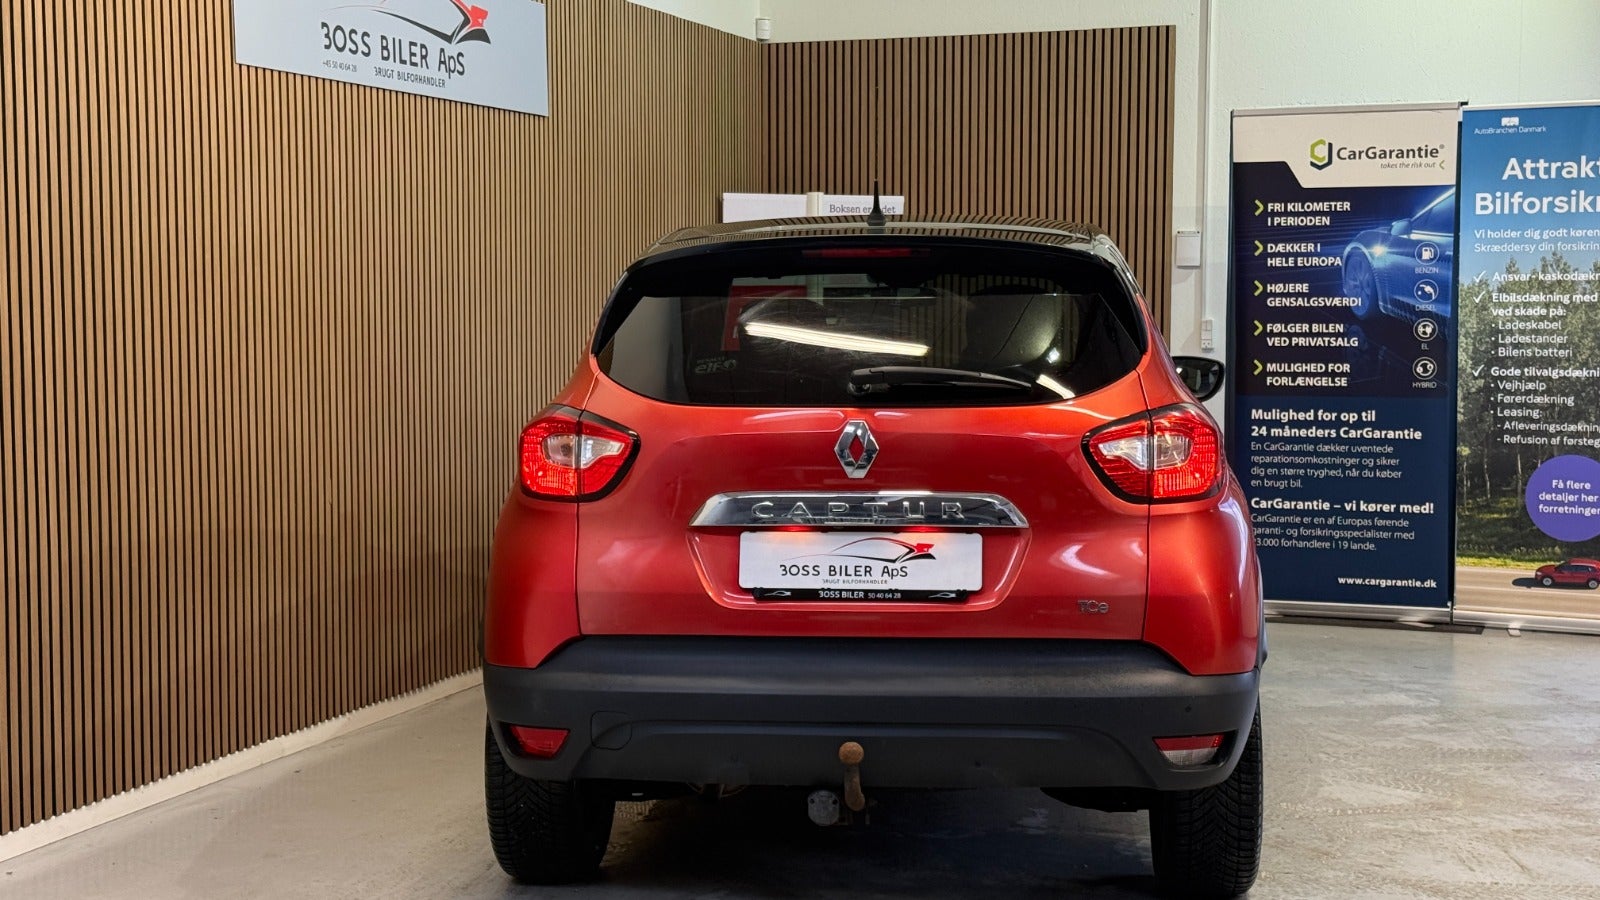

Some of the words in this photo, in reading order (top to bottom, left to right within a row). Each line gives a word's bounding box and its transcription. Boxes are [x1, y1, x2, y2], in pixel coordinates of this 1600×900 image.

[380, 35, 429, 69] BILER
[438, 47, 465, 79] ApS
[397, 71, 446, 88] BILFORHANDLER
[1474, 127, 1517, 135] AutoBranchen
[1399, 161, 1410, 169] the
[829, 204, 860, 213] Boksen
[881, 205, 896, 213] det
[1268, 203, 1284, 212] FRI
[1287, 202, 1350, 212] KILOMETER
[1274, 216, 1330, 226] PERIODEN
[1474, 230, 1485, 239] Vi
[1487, 229, 1521, 238] holder
[1524, 229, 1540, 239] dig
[1543, 228, 1567, 239] godt
[1267, 243, 1315, 253] DÆKKER
[1474, 242, 1536, 253] Skræddersy
[1538, 242, 1554, 251] din
[1557, 241, 1600, 250] forsikrin
[1267, 257, 1295, 267] HELE
[1297, 257, 1342, 267] EUROPA
[1267, 283, 1309, 293] HØJERE
[1267, 297, 1361, 307] GENSALGSVÆRDI
[1492, 293, 1570, 304] Elbilsdækning
[1572, 292, 1598, 302] med
[1492, 307, 1512, 316] ved
[1514, 307, 1547, 316] skade
[1549, 306, 1567, 318] på:
[1266, 323, 1309, 333] FØLGER
[1312, 323, 1344, 333] BILEN
[1498, 320, 1561, 330] Ladeskabel
[1267, 337, 1289, 347] VED
[1292, 337, 1359, 347] PRIVATSALG
[1498, 334, 1568, 344] Ladestander
[1498, 347, 1532, 357] Bilens
[1535, 347, 1573, 357] batteri
[1266, 363, 1326, 373] MULIGHED
[1328, 363, 1350, 373] FOR
[1491, 366, 1521, 377] Gode
[1524, 366, 1600, 379] tilvalgsdækni
[1266, 376, 1348, 387] FORLÆNGELSE
[1497, 380, 1547, 390] Vejhjælp
[1498, 394, 1574, 406] Førerdækning
[1251, 409, 1314, 423] Mulighed
[1317, 409, 1337, 421] for
[1340, 413, 1358, 424] op
[1361, 410, 1376, 422] til
[1497, 408, 1543, 419] Leasing:
[1251, 426, 1267, 437] 24
[1271, 425, 1337, 438] måneders
[1339, 427, 1422, 440] CarGarantie
[1503, 421, 1600, 433] Afleveringsdæknin
[1503, 435, 1548, 445] Refusion
[1550, 436, 1560, 445] af
[1251, 442, 1261, 451] En
[1263, 442, 1314, 452] CarGarantie
[1316, 443, 1349, 453] dækker
[1351, 444, 1394, 453] uventede
[1251, 454, 1360, 466] reparationsomkostninger
[1362, 458, 1374, 467] og
[1376, 457, 1400, 466] sikrer
[1251, 467, 1265, 477] dig
[1267, 468, 1278, 476] en
[1280, 467, 1305, 477] større
[1306, 468, 1344, 478] tryghed,
[1345, 468, 1360, 478] når
[1362, 469, 1374, 478] du
[1376, 469, 1402, 479] køber
[1264, 479, 1288, 489] brugt
[1290, 479, 1303, 489] bil.
[1552, 480, 1564, 489] Få
[1566, 480, 1591, 490] flere
[1539, 492, 1578, 503] detaljer
[1581, 492, 1599, 502] her
[752, 501, 965, 519] CAPTUR
[1251, 497, 1330, 511] CarGarantie
[1344, 501, 1357, 512] vi
[1360, 500, 1397, 514] kører
[1400, 502, 1434, 514] med!
[1250, 514, 1301, 524] CarGarantie
[1302, 516, 1312, 524] er
[1313, 517, 1325, 525] en
[1327, 515, 1336, 525] af
[1337, 517, 1372, 528] Europas
[1374, 517, 1409, 528] førende
[1285, 528, 1298, 537] og
[1300, 527, 1392, 539] forsikringsspecialister
[1394, 531, 1415, 540] med
[1254, 538, 1279, 547] 3.000
[1281, 538, 1330, 549] forhandlere
[1338, 541, 1348, 550] 19
[1350, 541, 1376, 551] lande.
[829, 565, 873, 578] BILER
[881, 566, 908, 580] ApS
[1338, 576, 1437, 588] www.cargarantie.dk
[841, 591, 864, 599] BILER
[1078, 600, 1109, 613] TCe
